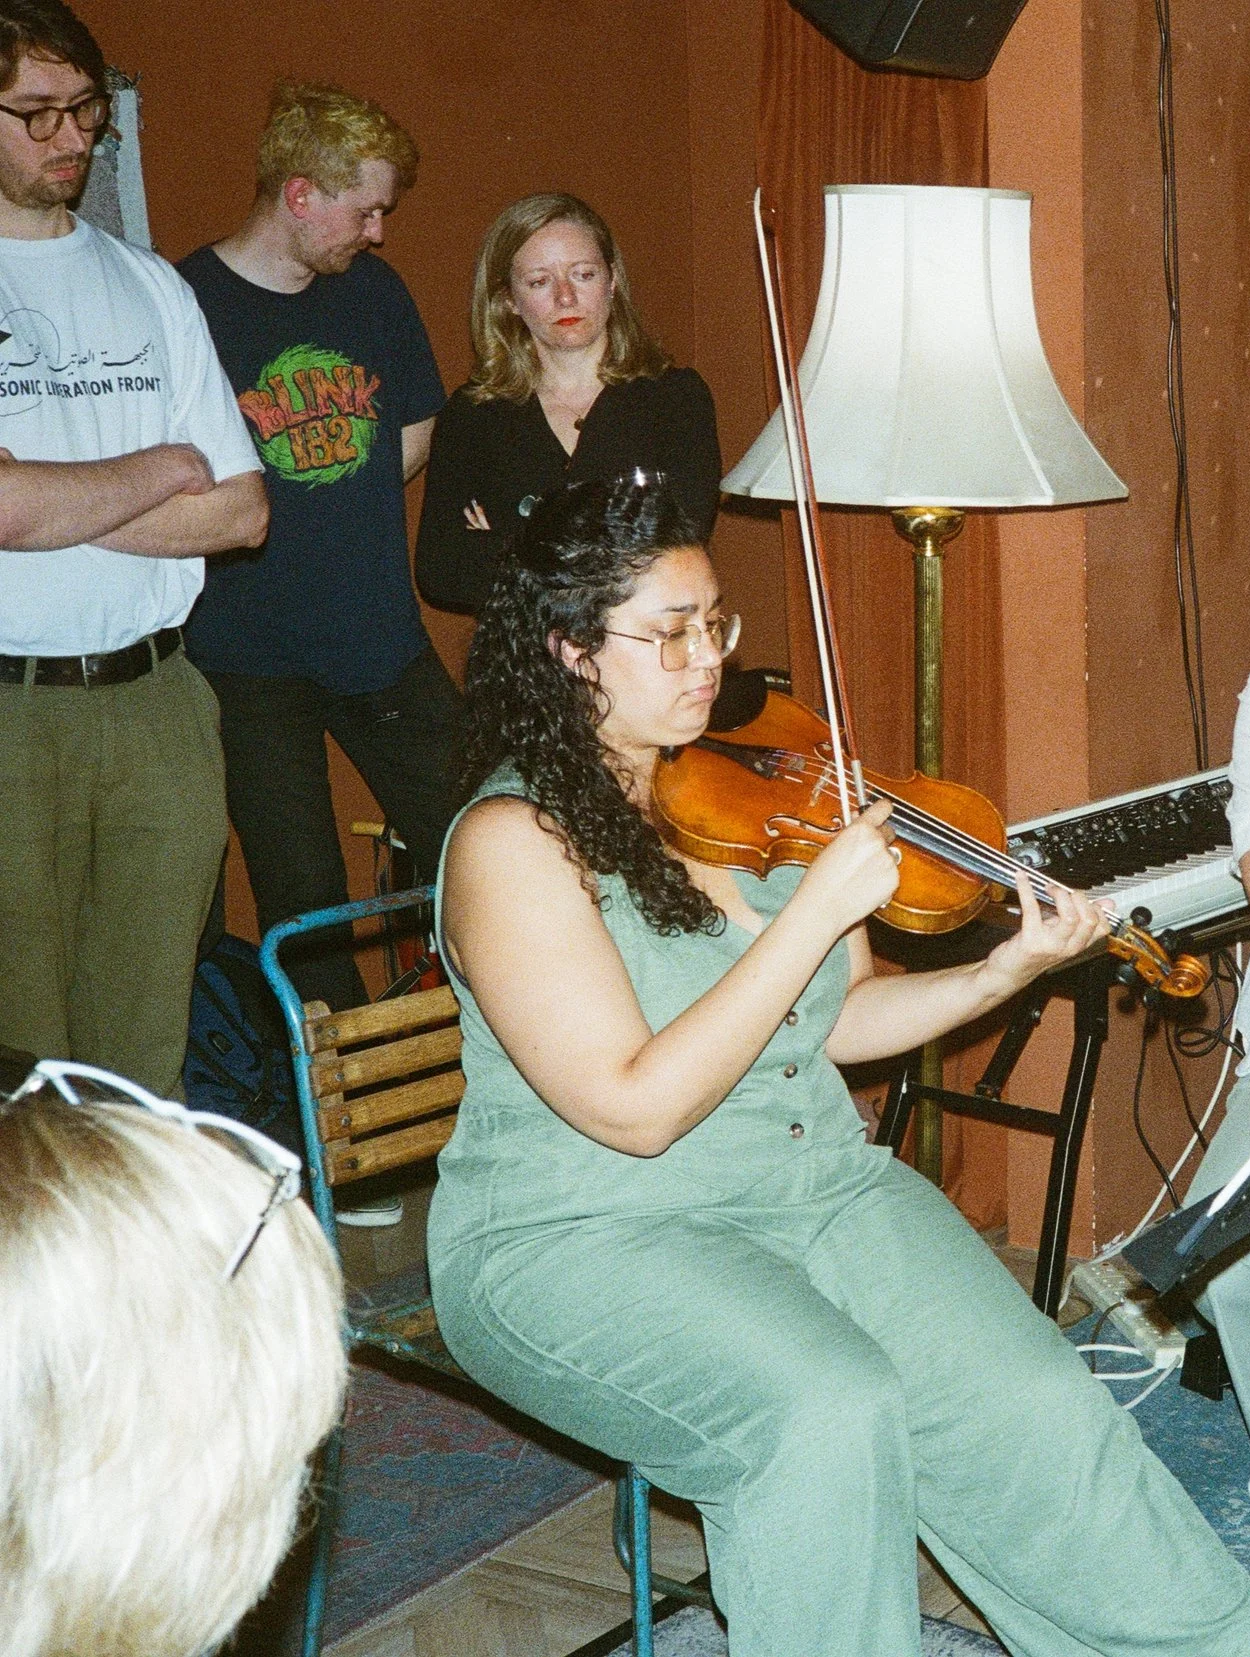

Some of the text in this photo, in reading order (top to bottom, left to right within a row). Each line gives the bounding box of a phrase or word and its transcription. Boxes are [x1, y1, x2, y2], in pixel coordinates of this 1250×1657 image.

[0, 379, 42, 397] SONIC
[118, 376, 161, 392] FRONT
[237, 365, 381, 440] BLINK
